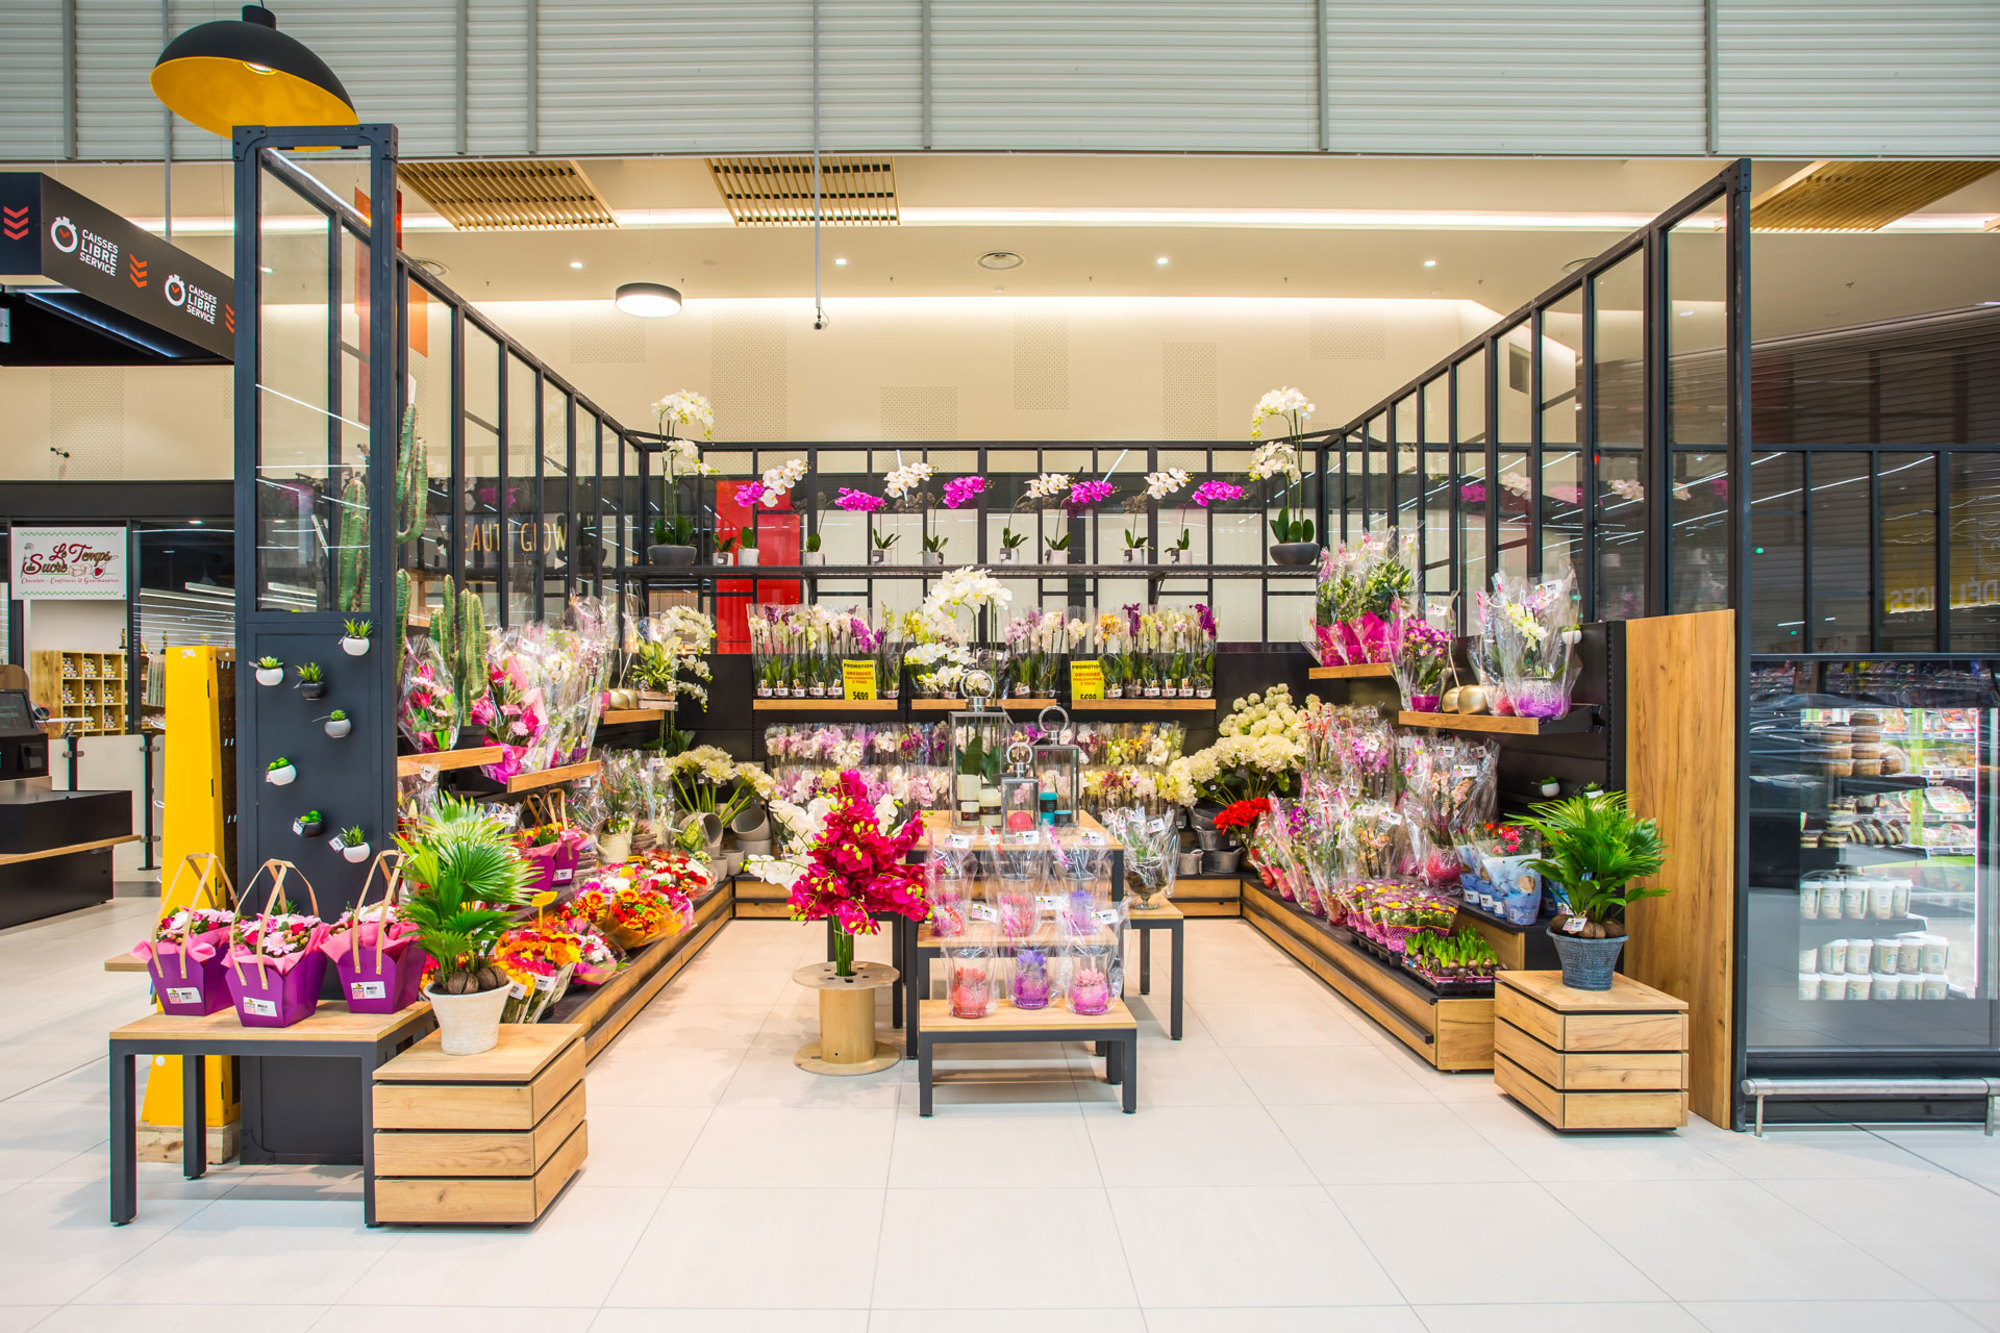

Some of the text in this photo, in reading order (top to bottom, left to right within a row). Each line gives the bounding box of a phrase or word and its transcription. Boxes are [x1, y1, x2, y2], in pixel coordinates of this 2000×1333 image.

[81, 229, 119, 254] CAISSES
[79, 252, 117, 277] SERVICE
[80, 241, 118, 267] LIBRE
[187, 293, 217, 316] LIBRE
[188, 284, 218, 305] CAISSES
[186, 304, 215, 325] SERVICE
[49, 543, 112, 567] Le Temps
